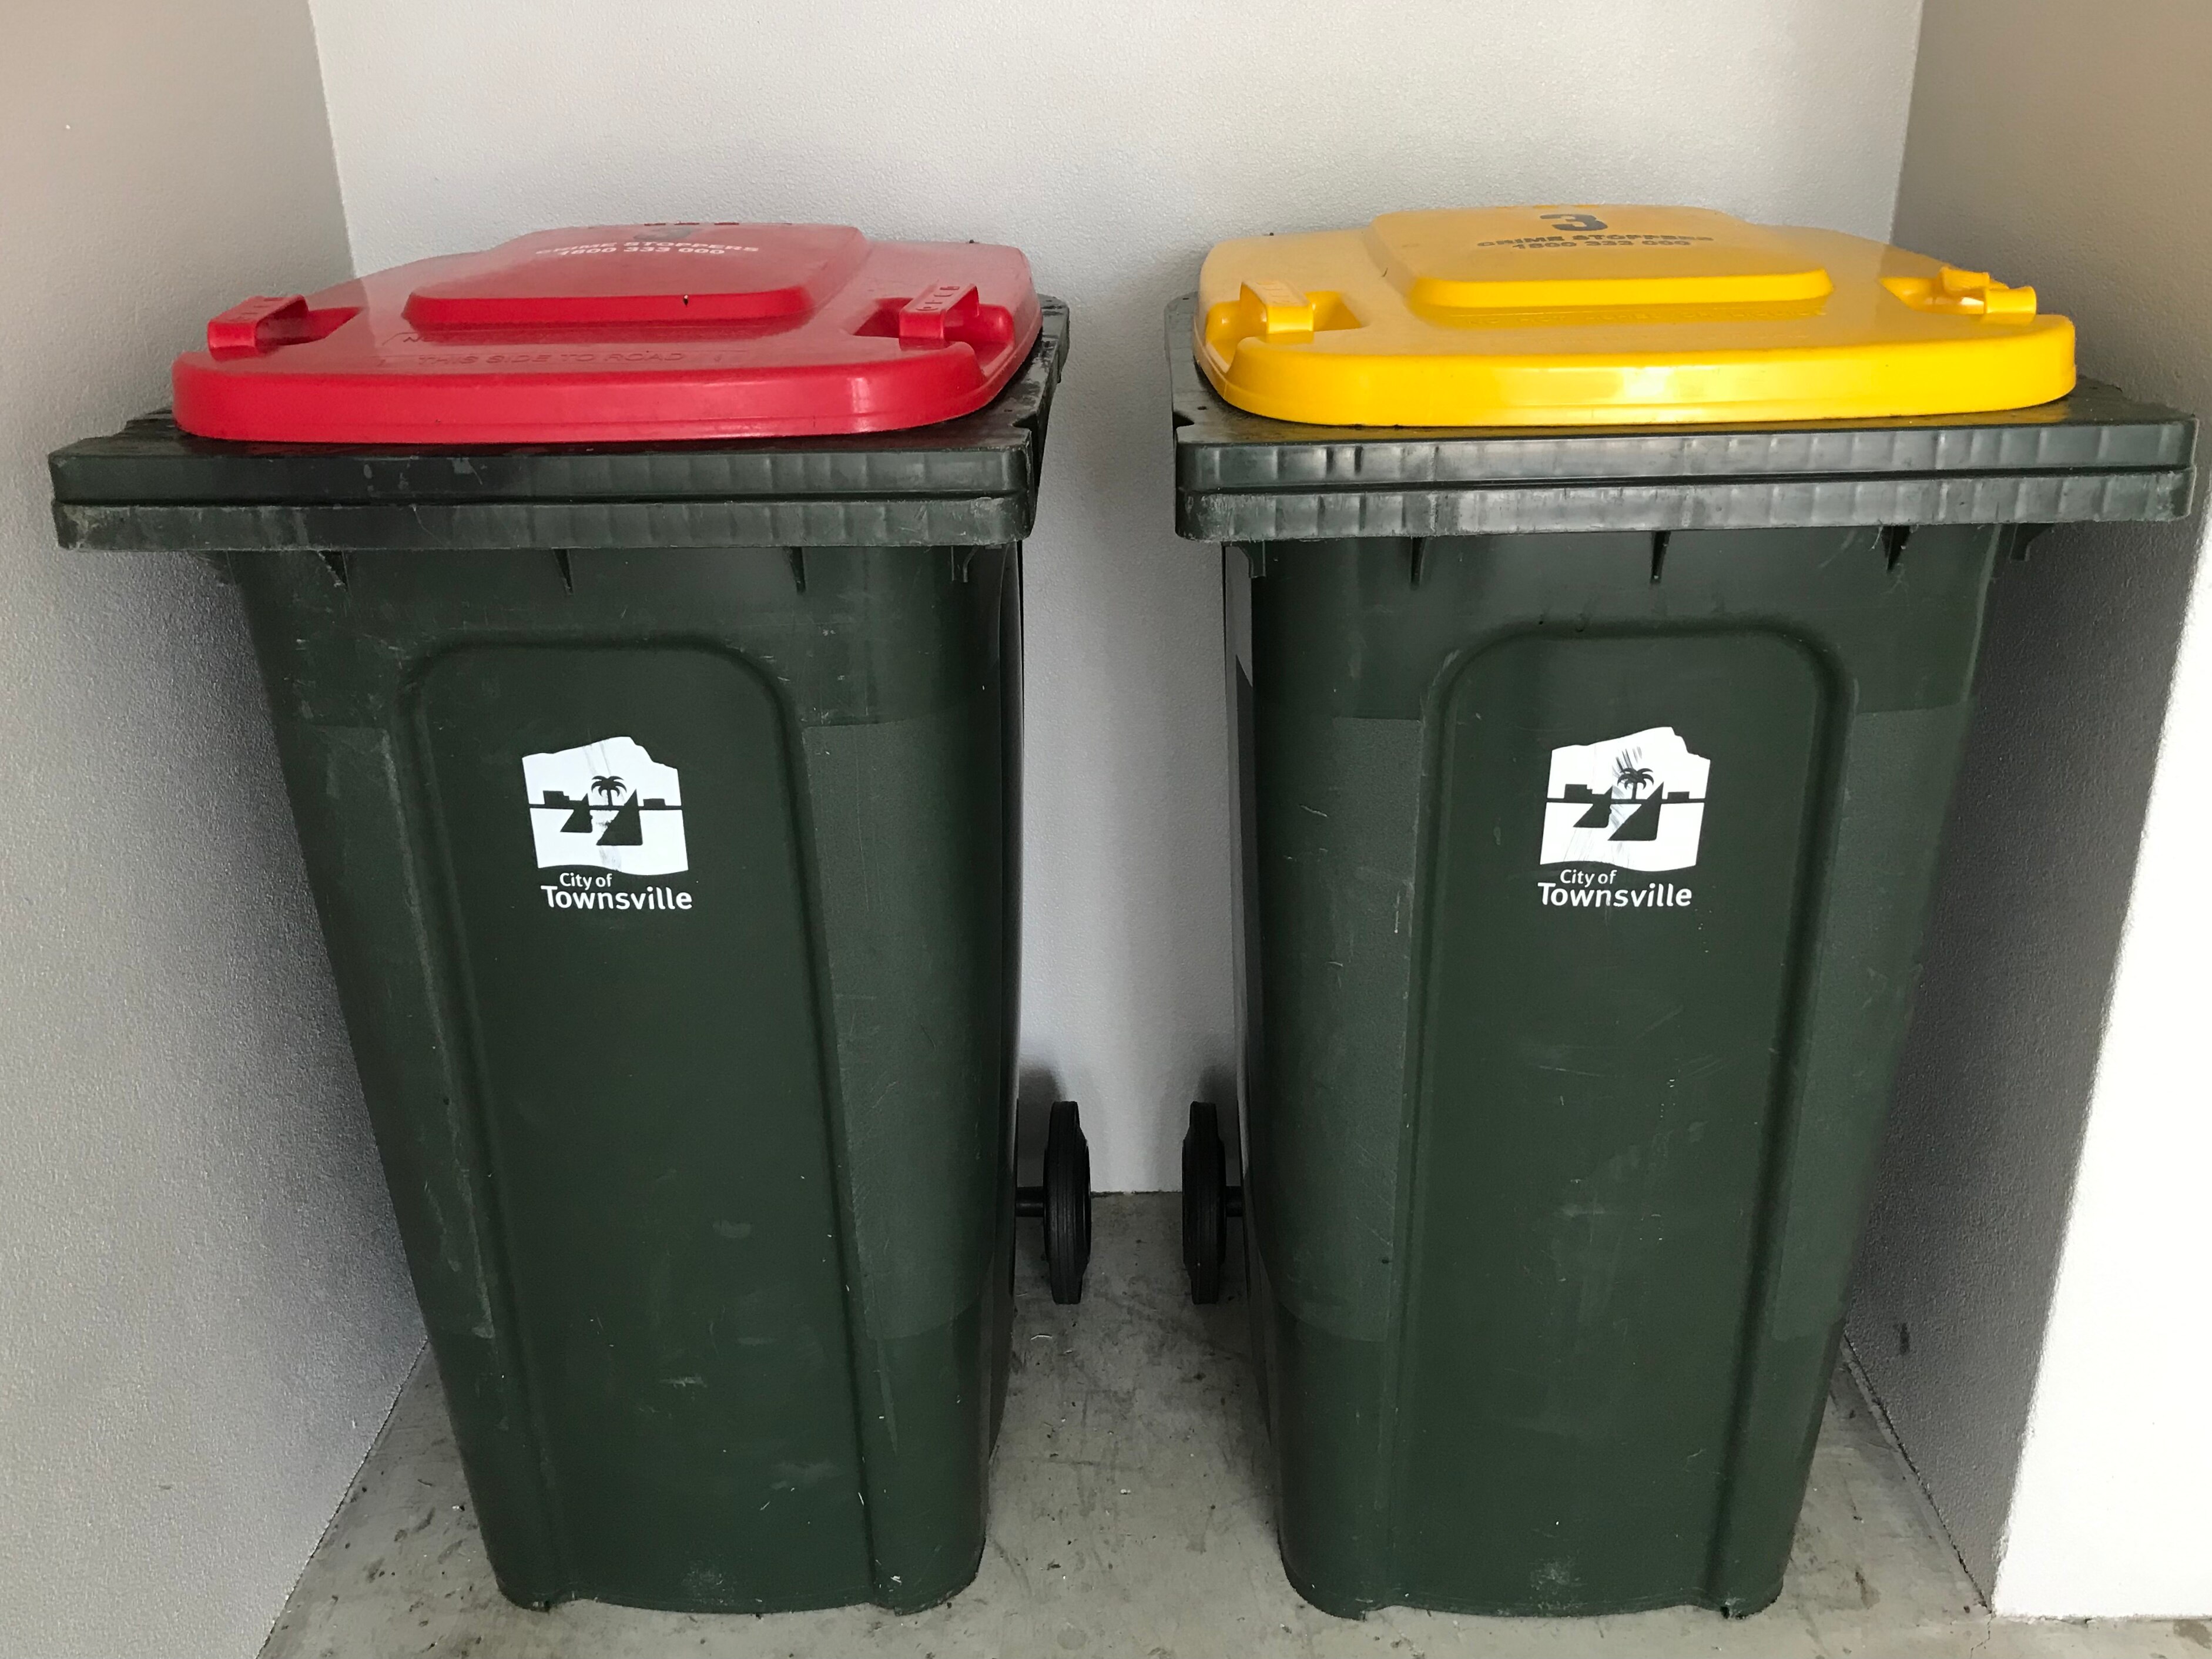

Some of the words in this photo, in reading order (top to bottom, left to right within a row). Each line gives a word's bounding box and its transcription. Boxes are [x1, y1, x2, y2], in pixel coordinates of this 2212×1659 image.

[1540, 214, 1608, 230] 3
[624, 242, 759, 252] STOPPERS
[1477, 236, 1563, 246] CRIME
[418, 354, 479, 365] THIS
[485, 354, 552, 363] SIDE
[561, 353, 596, 362] TO
[604, 353, 685, 361] ROAD
[559, 873, 592, 890] City
[595, 873, 612, 887] of
[1560, 869, 1595, 888] City
[1598, 870, 1617, 884] of
[541, 885, 692, 910] Townsville
[1537, 882, 1692, 907] Townsville
